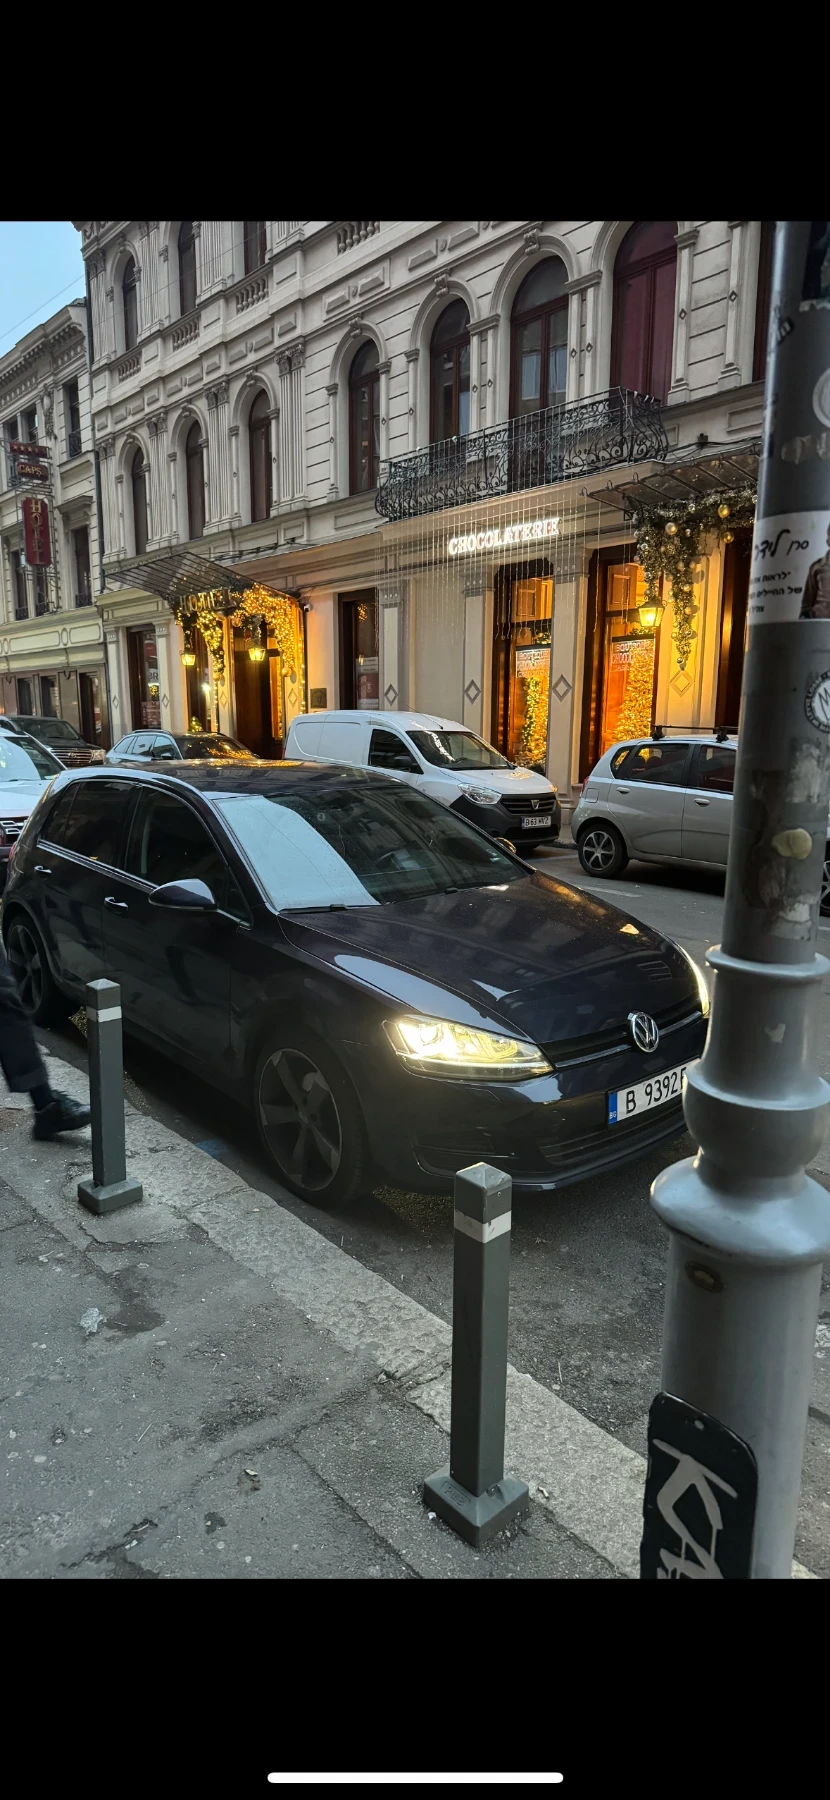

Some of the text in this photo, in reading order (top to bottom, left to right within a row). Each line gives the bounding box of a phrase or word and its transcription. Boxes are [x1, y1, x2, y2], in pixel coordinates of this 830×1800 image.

[31, 500, 44, 564] HOTEL
[449, 518, 560, 555] CHOCOLATERIE
[180, 587, 237, 613] HOTEL
[626, 1090, 636, 1115] B
